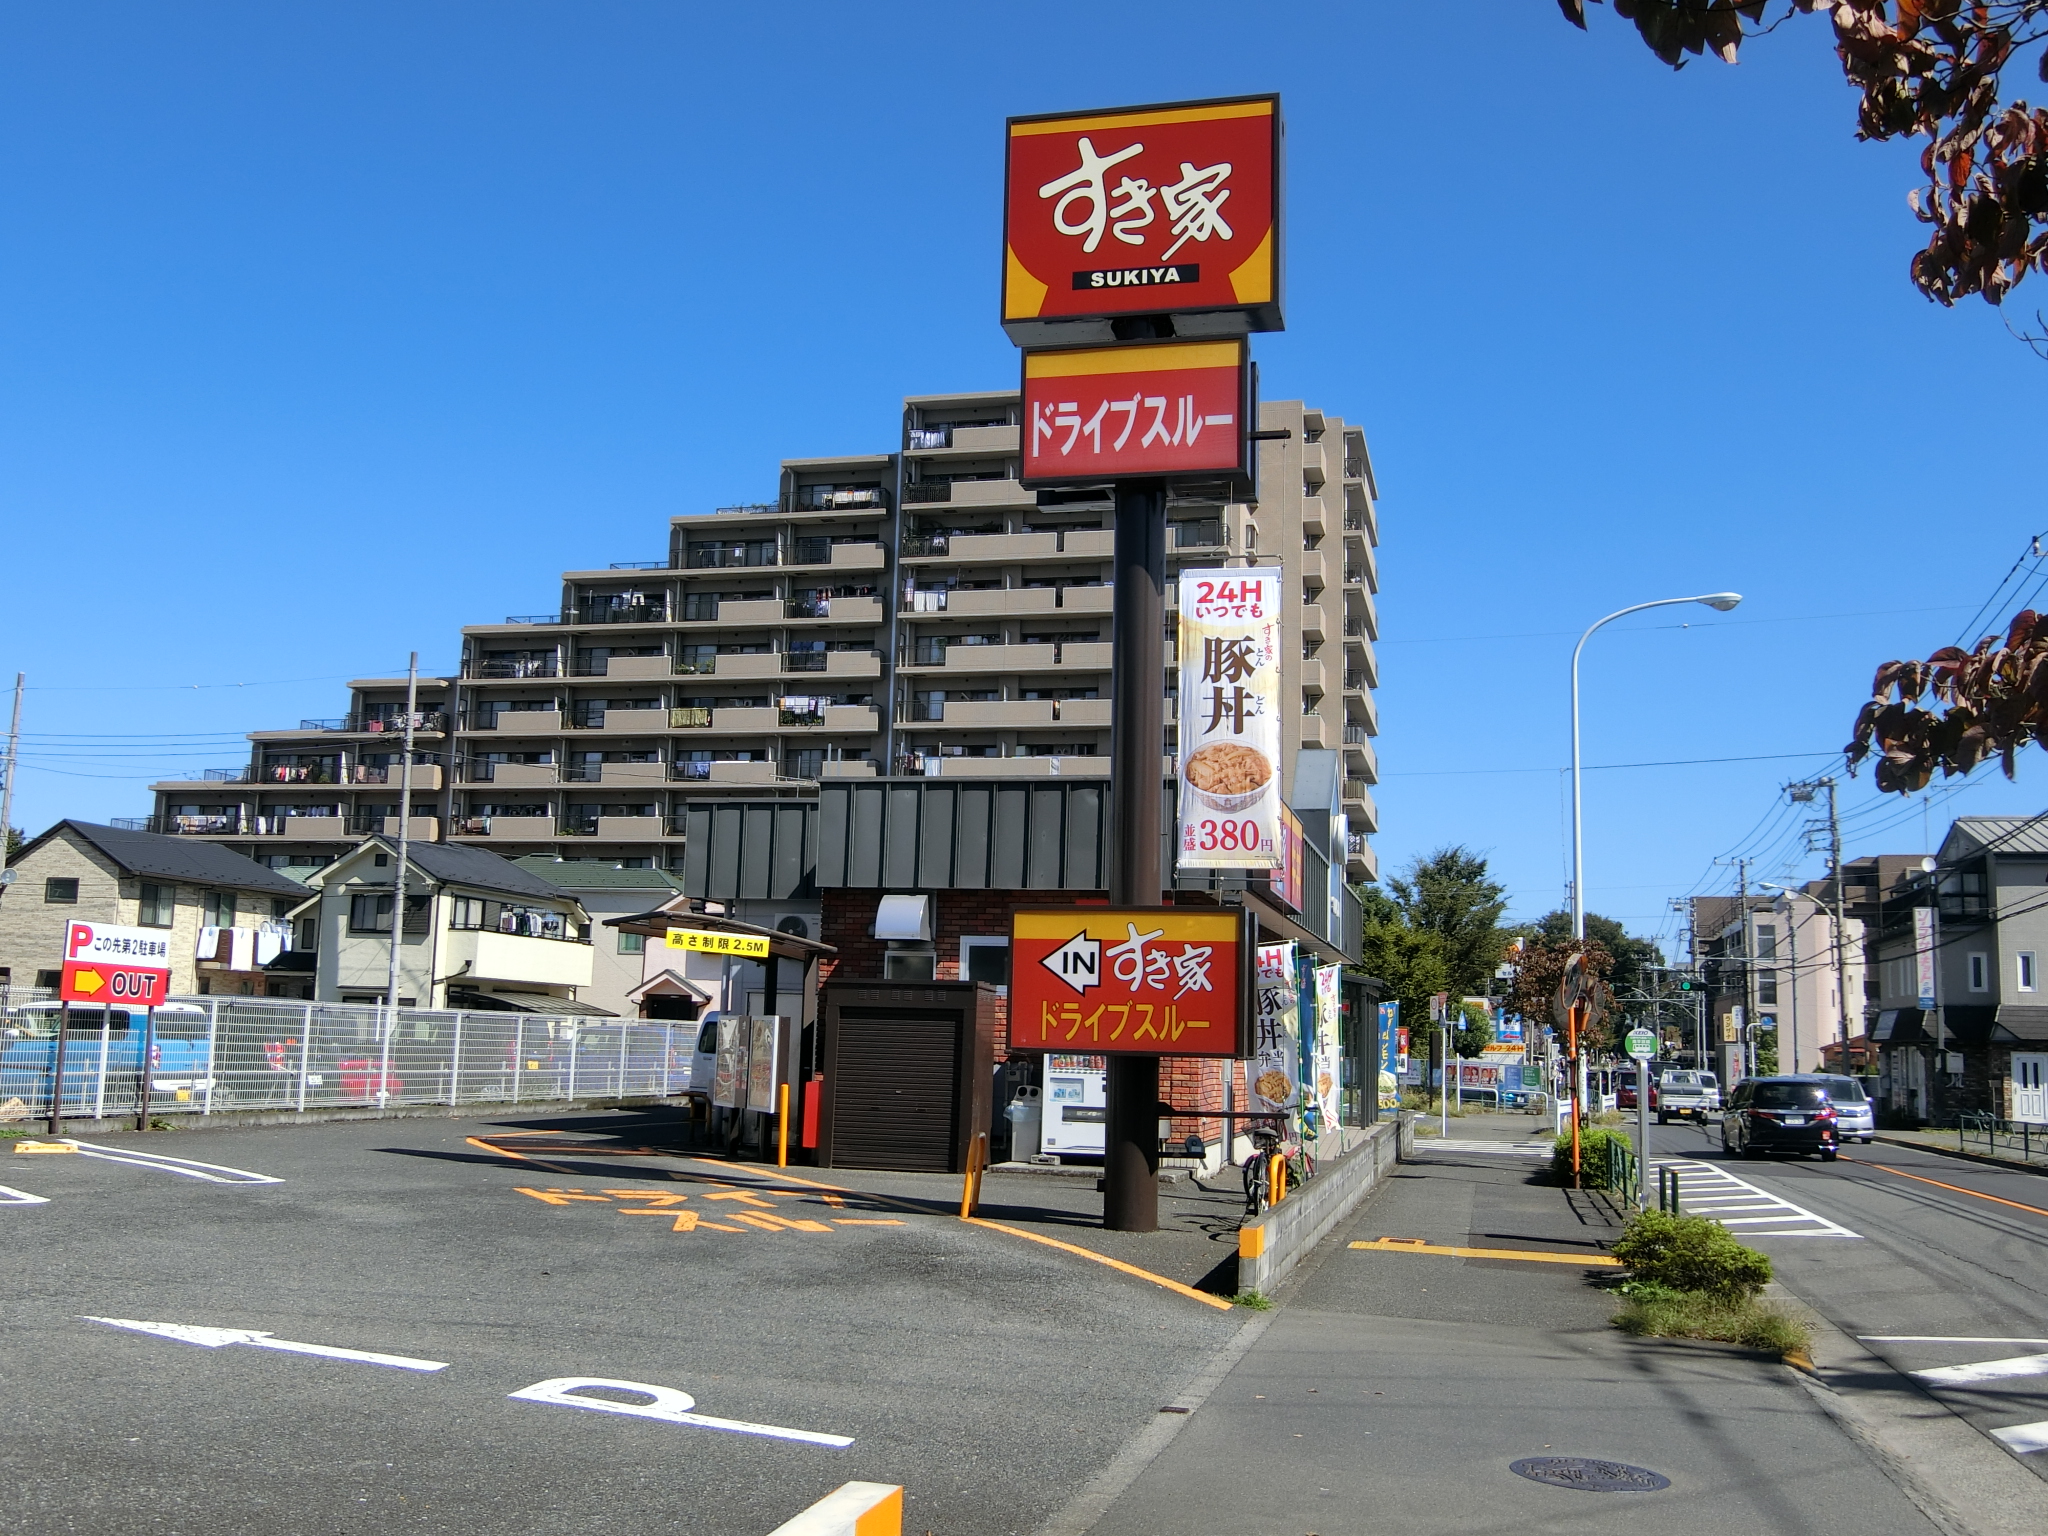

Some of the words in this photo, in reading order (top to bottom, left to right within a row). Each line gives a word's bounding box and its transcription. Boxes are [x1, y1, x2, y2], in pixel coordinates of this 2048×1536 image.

[1038, 136, 1234, 261] すき家
[1090, 267, 1181, 288] SUKIYA
[1032, 391, 1234, 458] ドライブスルー
[1196, 580, 1262, 604] 24H
[1195, 603, 1263, 619] いつでも
[1262, 623, 1275, 662] すき家の
[1201, 635, 1256, 736] 豚丼
[1183, 824, 1197, 851] 並盛
[1199, 819, 1273, 852] 380円
[69, 923, 94, 958] P
[94, 937, 167, 958] この先第2駐車場
[671, 933, 764, 953] 高さ制限2.5M
[1062, 951, 1096, 975] IN
[1105, 921, 1213, 1000] すき家
[111, 971, 157, 998] OUT
[1041, 1000, 1210, 1042] ドライブスルー
[1258, 1050, 1284, 1068] 弁当
[617, 1208, 908, 1233] スルー
